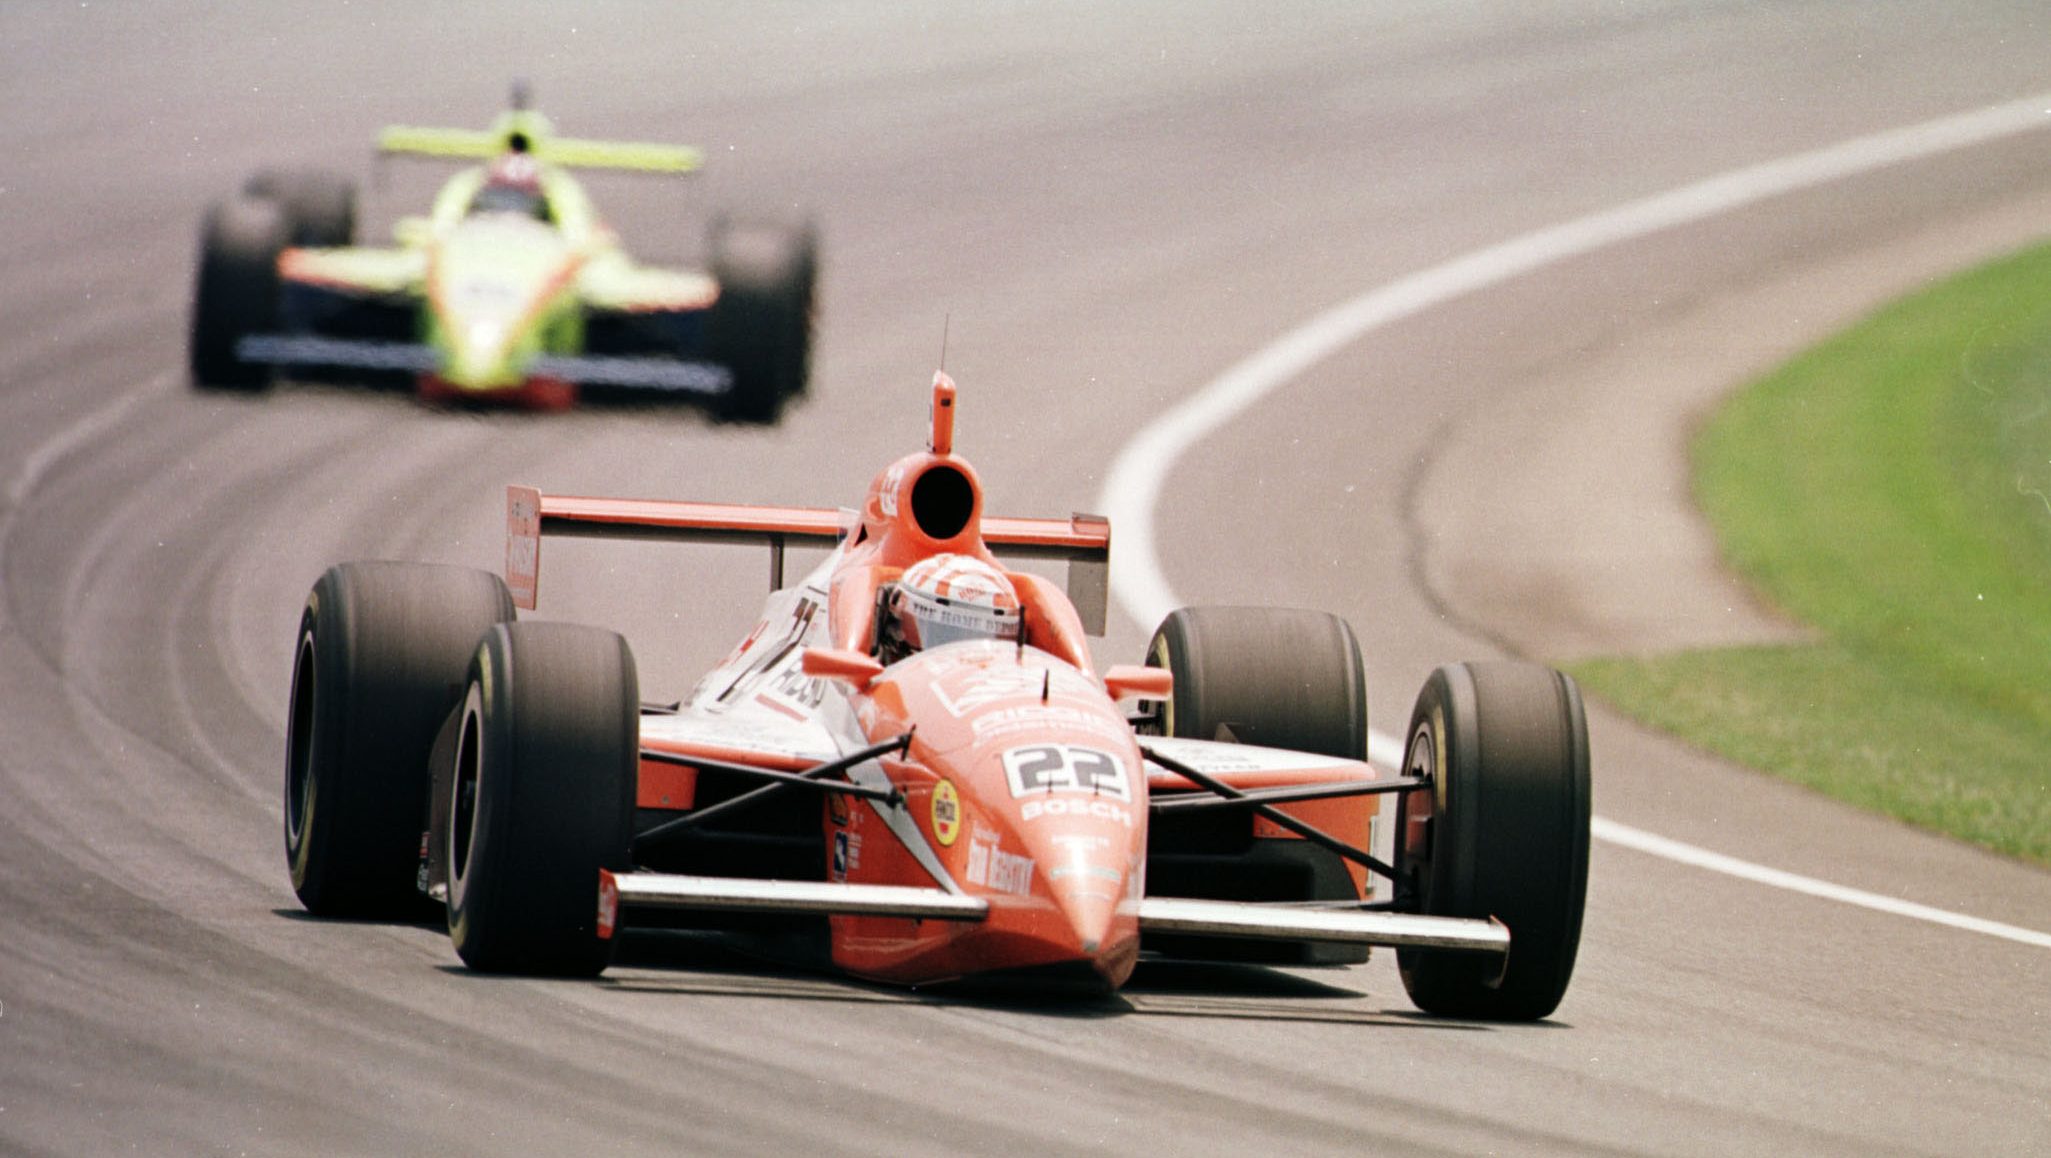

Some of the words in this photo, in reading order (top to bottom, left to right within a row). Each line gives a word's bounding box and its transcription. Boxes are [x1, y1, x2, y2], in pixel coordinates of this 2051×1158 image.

[913, 602, 936, 617] THE
[941, 610, 981, 628] HOME
[1013, 747, 1123, 795] 22
[1021, 798, 1132, 828] BOSCH
